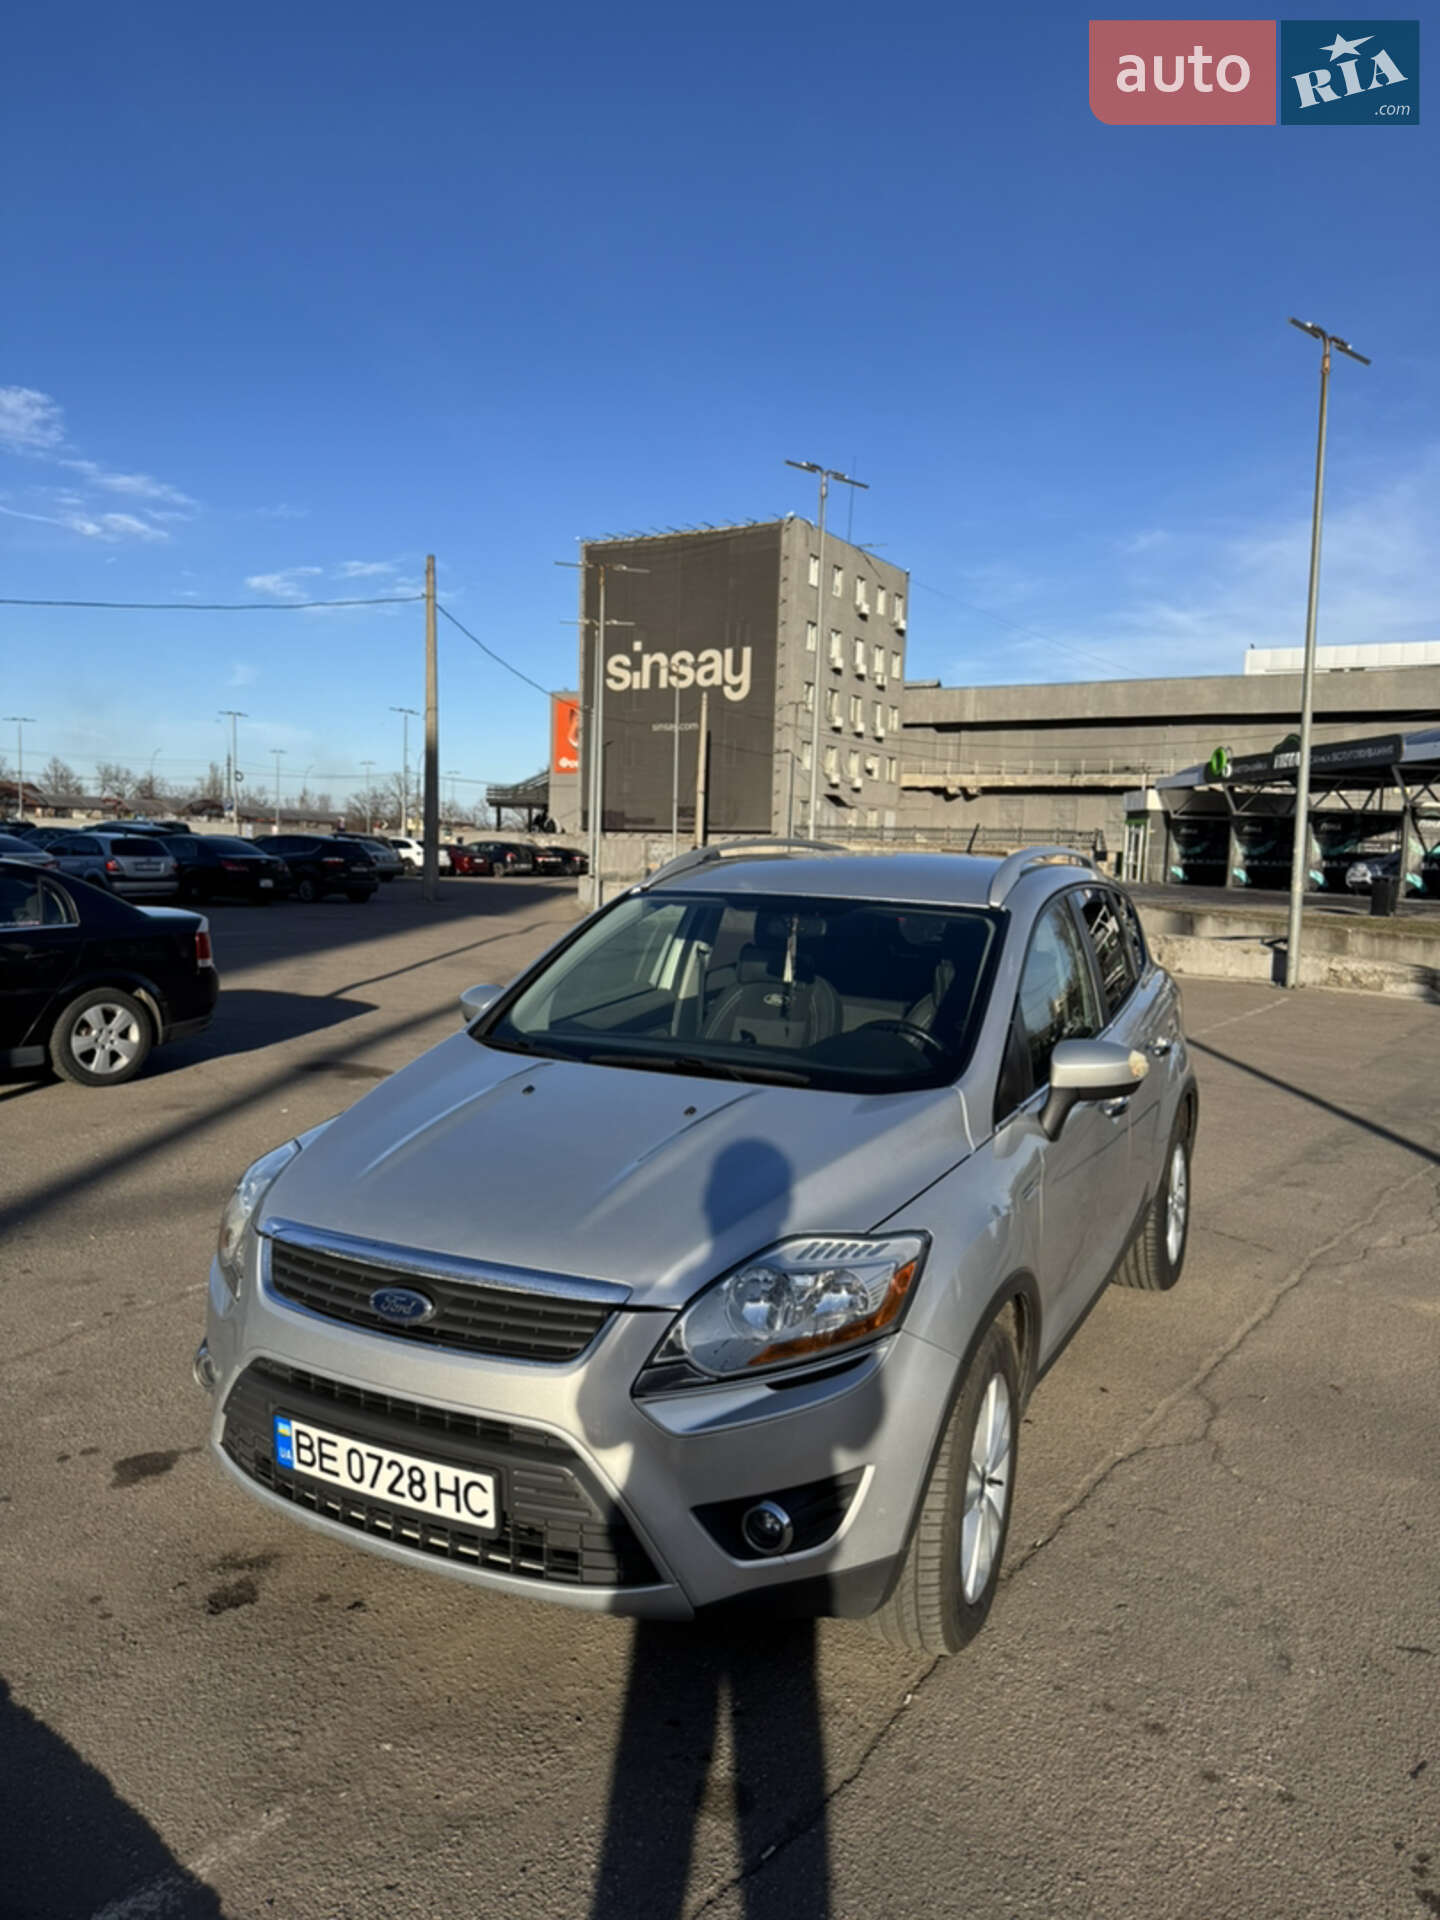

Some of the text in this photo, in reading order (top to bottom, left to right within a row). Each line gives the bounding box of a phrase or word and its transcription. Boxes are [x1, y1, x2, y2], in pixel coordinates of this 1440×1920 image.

[605, 641, 752, 702] sinsay
[381, 1294, 417, 1315] Ford
[294, 1429, 489, 1519] BE 0728 HC
